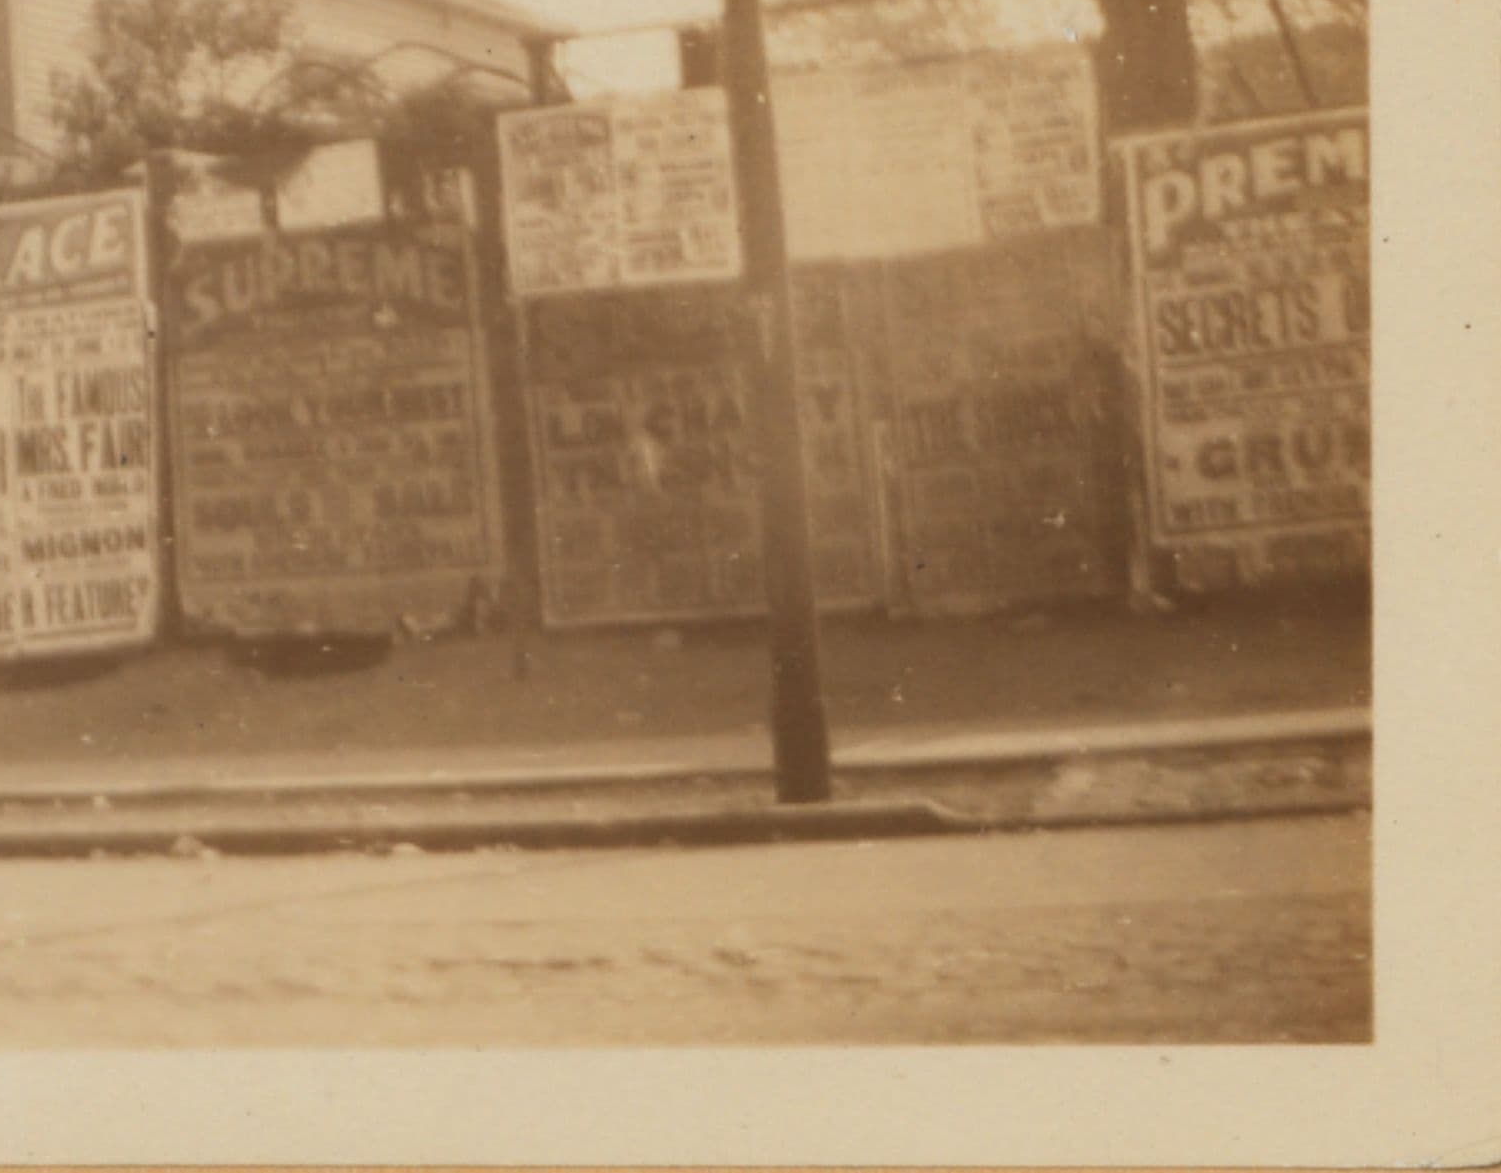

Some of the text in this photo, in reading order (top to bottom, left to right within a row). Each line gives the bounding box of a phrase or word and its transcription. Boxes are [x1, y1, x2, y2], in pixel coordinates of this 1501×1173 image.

[1145, 131, 1365, 254] PREM
[184, 241, 465, 327] SUPREME
[1157, 288, 1321, 358] SECRETS
[78, 420, 148, 474] FAIR
[21, 527, 145, 563] MIGNON
